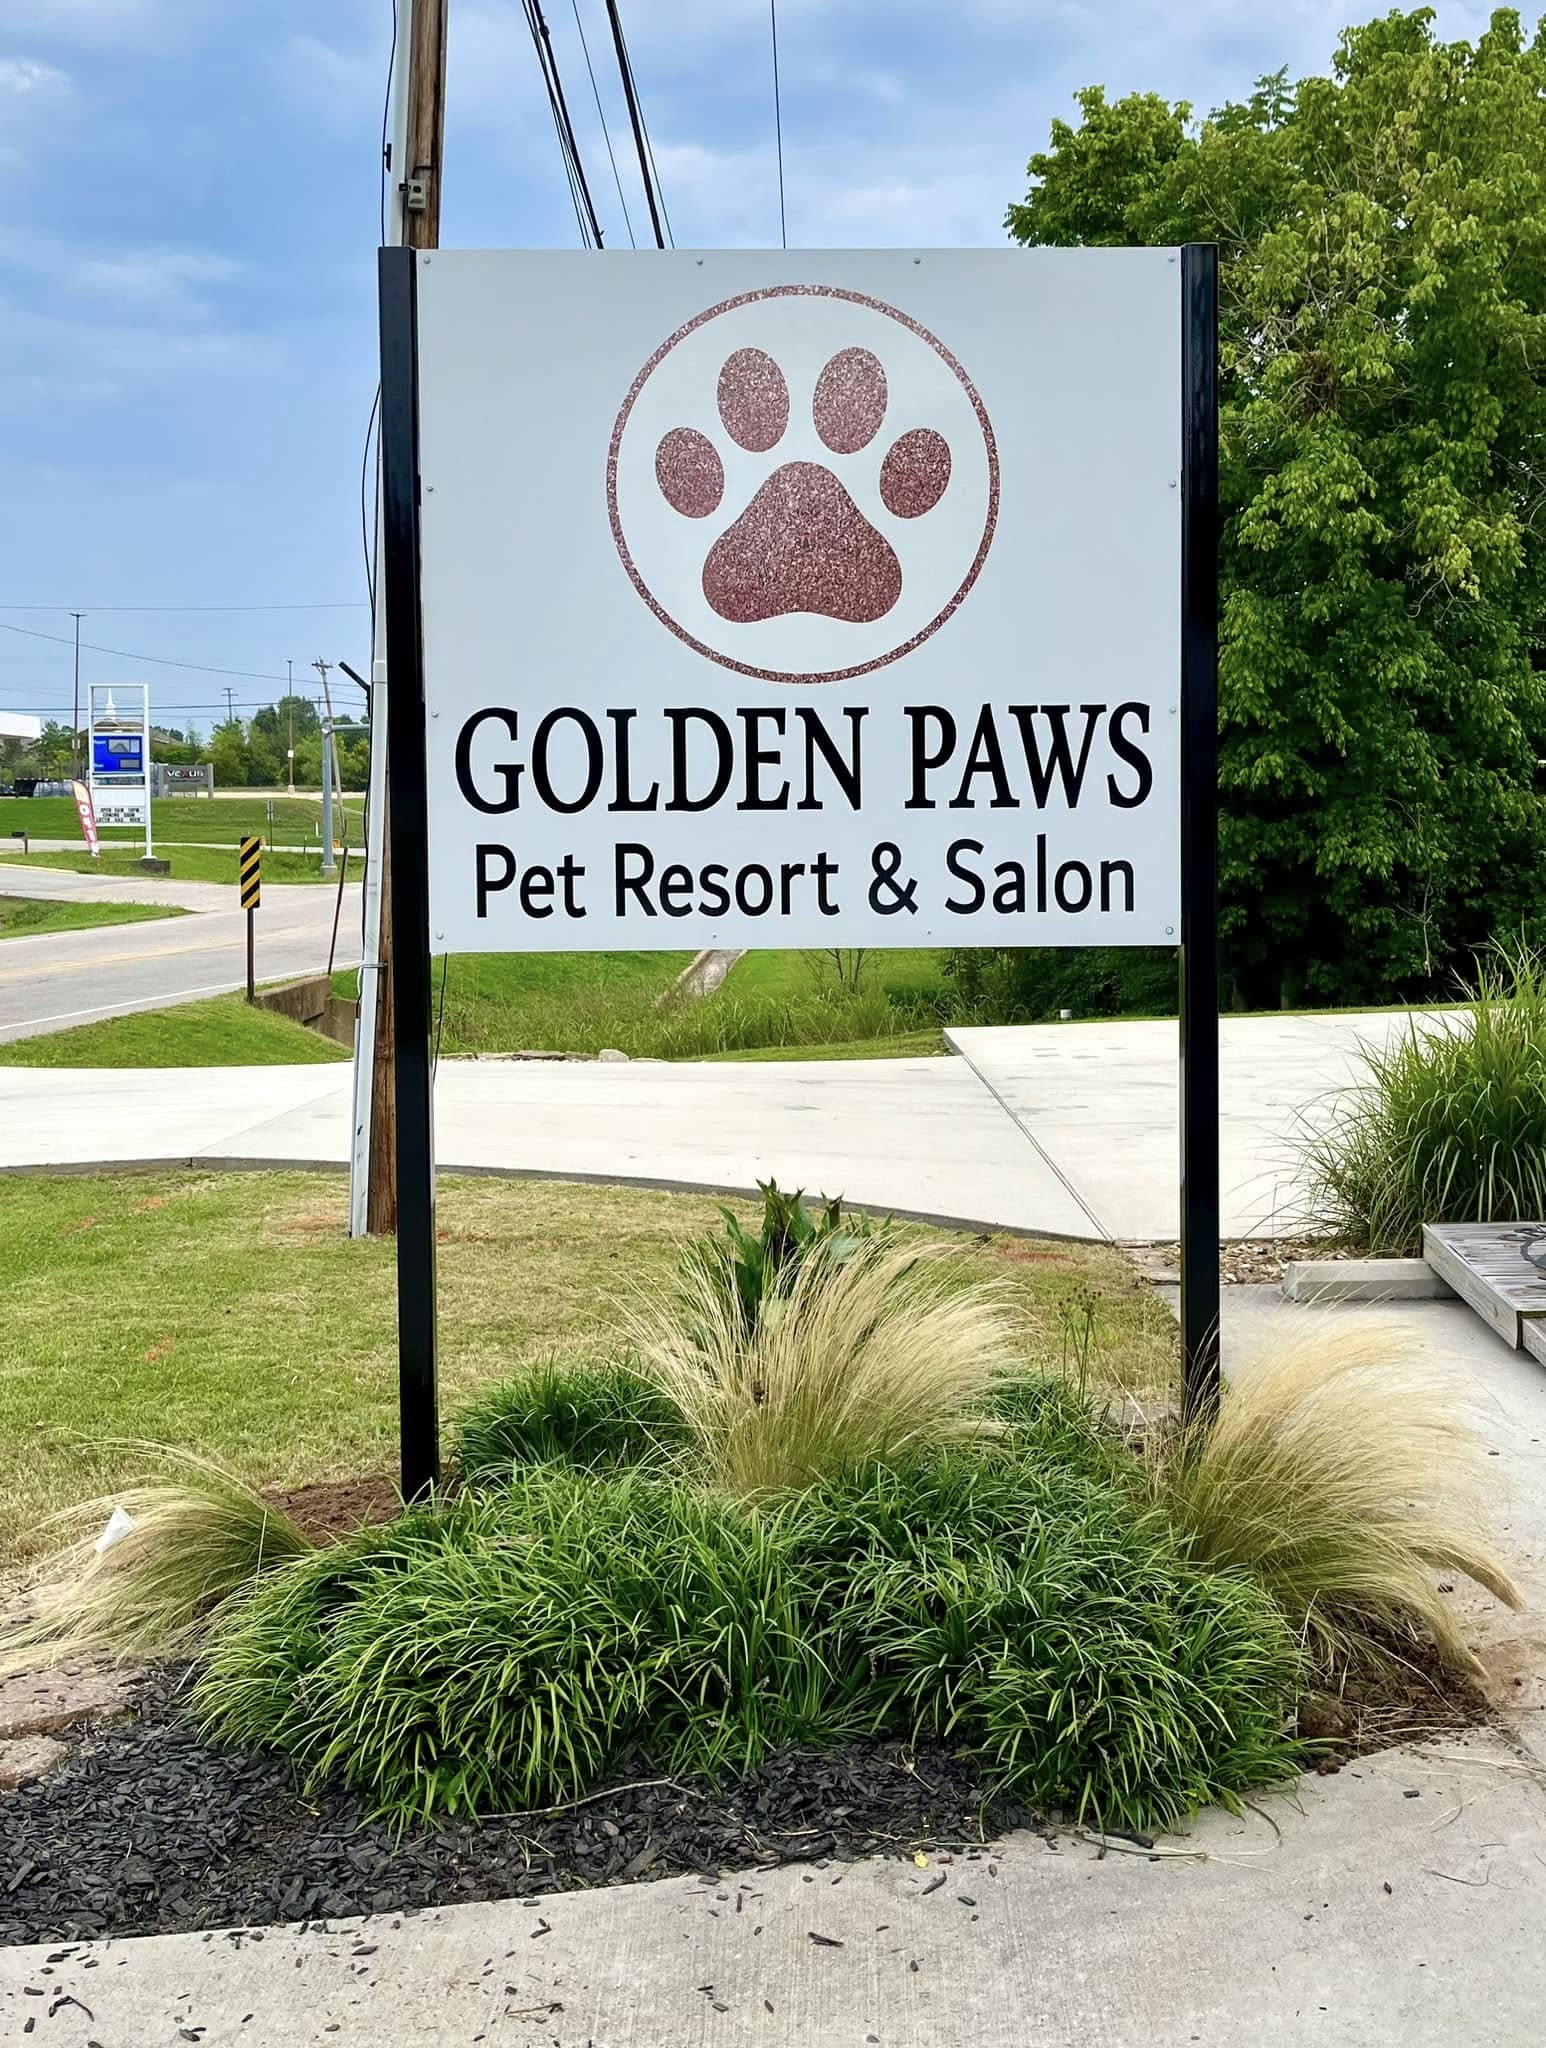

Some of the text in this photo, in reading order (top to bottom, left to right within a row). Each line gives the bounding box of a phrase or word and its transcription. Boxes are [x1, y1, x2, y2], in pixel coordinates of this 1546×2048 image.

[456, 702, 1153, 815] GOLDEN PAWS
[476, 834, 1134, 919] Pet Resort & Salon
